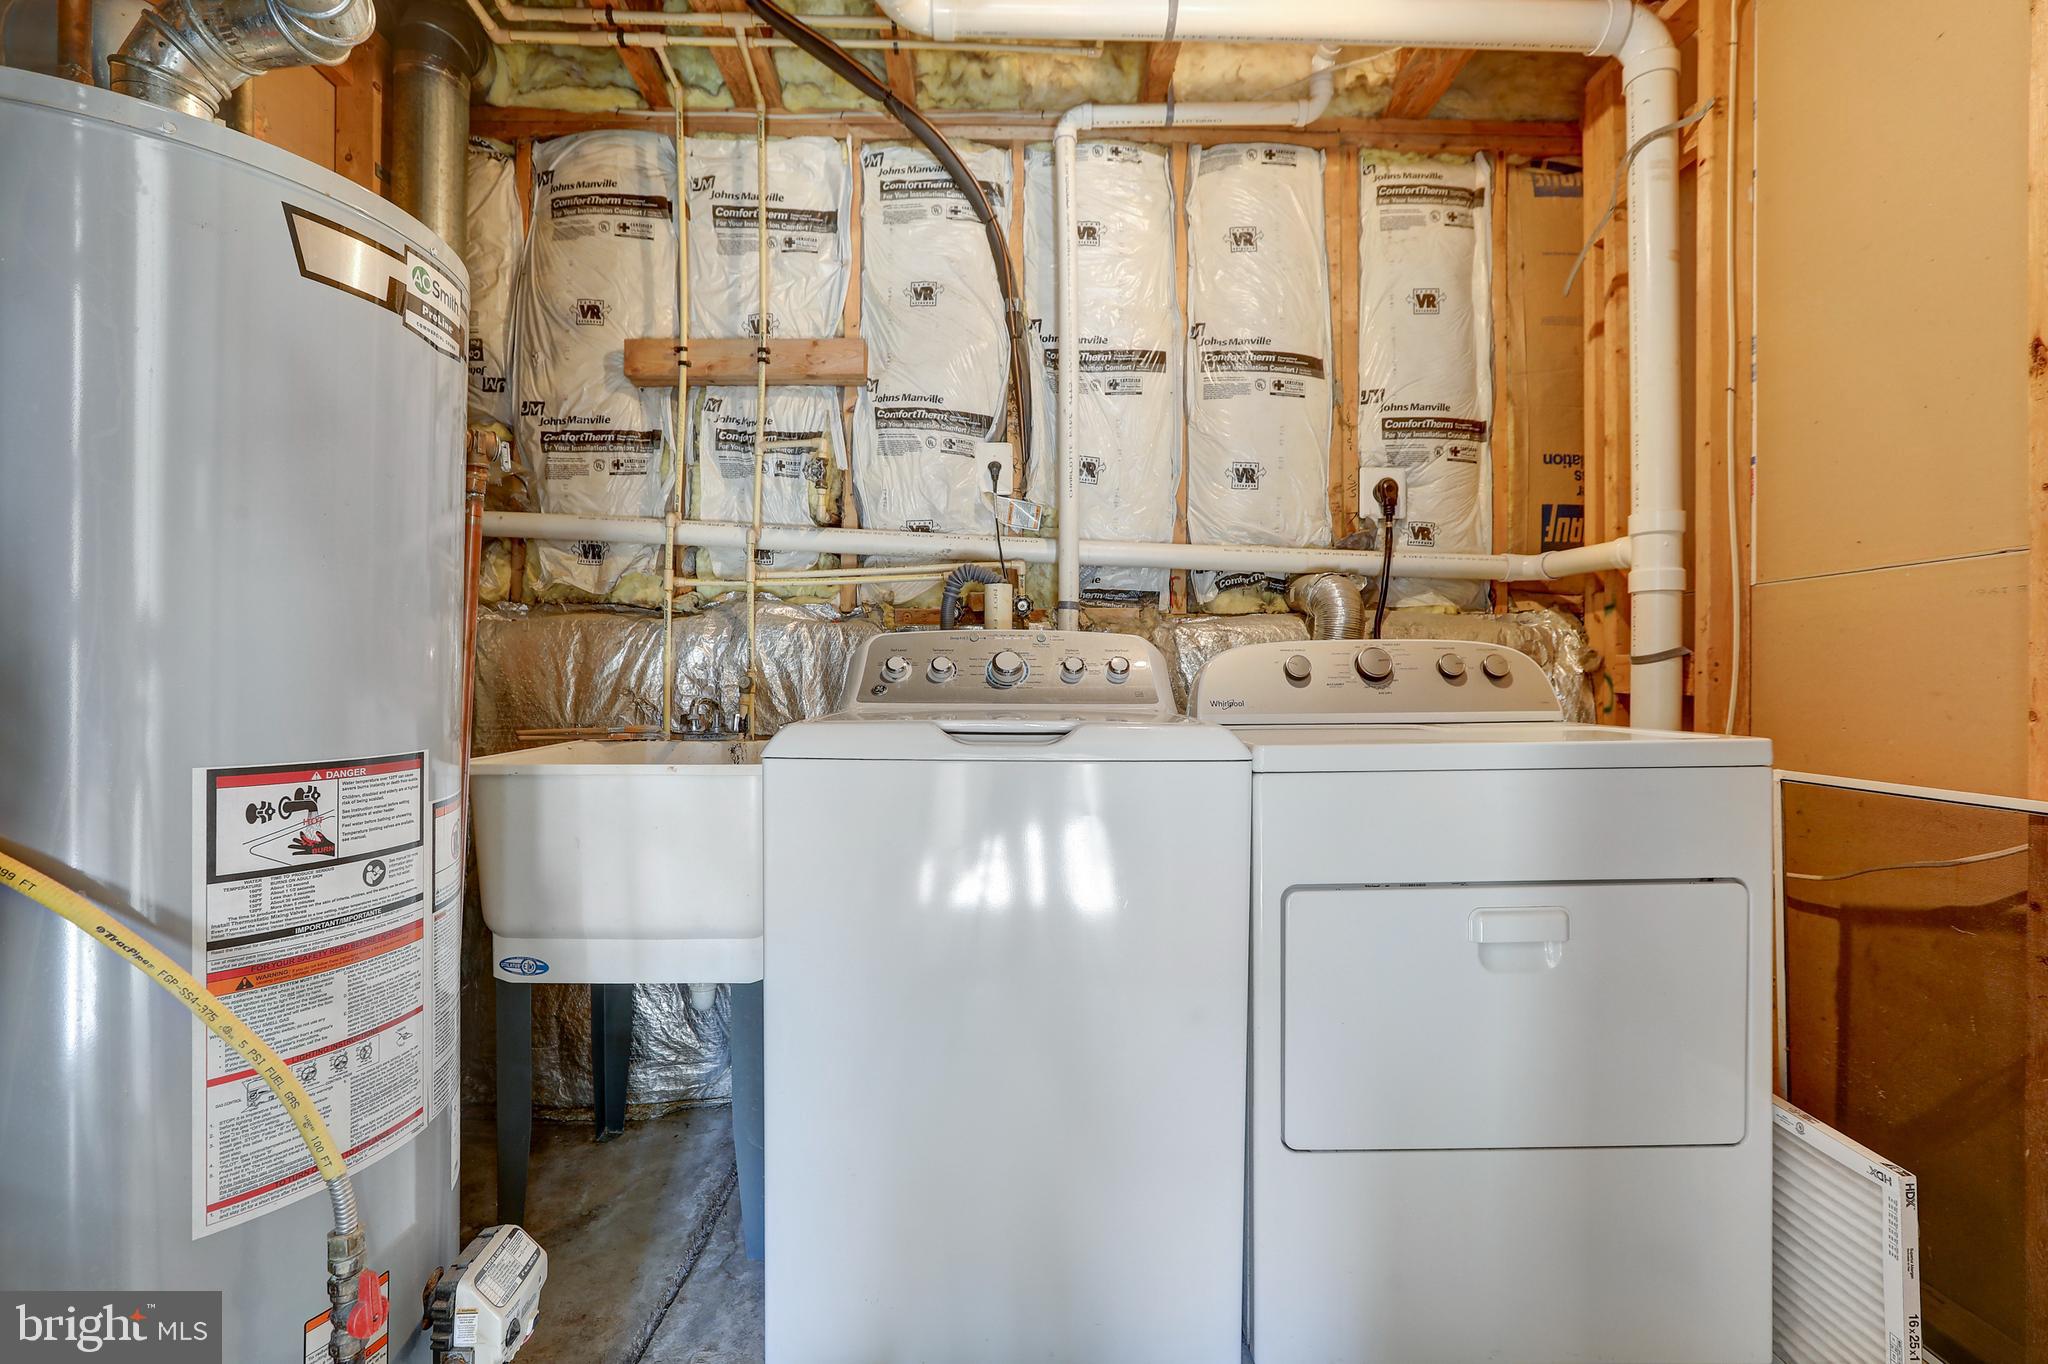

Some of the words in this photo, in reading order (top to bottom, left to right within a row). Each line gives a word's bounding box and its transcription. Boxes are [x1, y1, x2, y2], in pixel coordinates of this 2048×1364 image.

[878, 165, 906, 177] Johns
[1373, 173, 1401, 182] Johns
[1402, 172, 1444, 180] Manville
[550, 181, 575, 194] Johns
[576, 179, 618, 189] Manville
[882, 181, 953, 191] ComfortTherm
[1378, 186, 1449, 196] ComfortTherm
[552, 195, 622, 209] ComfortTherm
[709, 191, 741, 201] Johns
[563, 207, 577, 215] Your
[577, 207, 613, 215] Installation
[614, 208, 642, 217] Comfort
[715, 220, 728, 228] For
[728, 220, 744, 228] Your
[781, 223, 809, 232] Comfort
[1077, 225, 1098, 240] VR
[1231, 232, 1255, 246] VR
[432, 281, 461, 317] Smith
[912, 287, 934, 301] VR
[1415, 293, 1438, 309] VR
[579, 304, 602, 320] VR
[421, 304, 454, 333] ProLine
[1200, 337, 1228, 346] Johns
[1228, 336, 1272, 346] Manville
[1204, 353, 1276, 362] ComfortTherm
[1269, 365, 1295, 373] Comfort
[482, 376, 506, 393] JM
[872, 393, 900, 403] Johns
[901, 393, 944, 404] Manville
[1380, 402, 1409, 414] Johns
[1410, 403, 1451, 412] Manville
[538, 416, 567, 427] Johns
[567, 415, 611, 425] Manville
[876, 409, 948, 421] ComfortTherm
[888, 421, 903, 429] Your
[903, 421, 940, 430] Installation
[940, 424, 967, 434] Comfort
[1384, 419, 1454, 429] ComfortTherm
[1447, 432, 1471, 440] Comfort
[554, 444, 571, 452] Your
[571, 444, 608, 452] Installation
[1234, 467, 1256, 483] VR
[1411, 526, 1432, 541] VR
[582, 543, 603, 559] VR
[1209, 699, 1245, 710] Whirlpool
[326, 768, 367, 779] DANGER
[303, 816, 324, 826] HOT
[342, 828, 368, 836] Temperature
[311, 846, 336, 855] BURN
[19, 879, 37, 892] FT
[223, 883, 263, 892] TEMPERATURE
[294, 907, 382, 935] IMPORTANT/IMPORTANTE
[250, 963, 270, 973] FOR
[271, 957, 297, 968] YOUR
[298, 949, 328, 963] SAFETY
[330, 943, 351, 955] READ
[156, 969, 219, 1023] FGP-SS4-375
[238, 1039, 247, 1049] 5
[247, 1048, 266, 1065] PSI
[264, 1066, 285, 1096] FUEL
[284, 1088, 300, 1109] GAS
[310, 1135, 324, 1154] 100
[320, 1152, 333, 1168] FT
[1868, 1165, 1893, 1186] HDX
[1904, 1182, 1916, 1208] HDX
